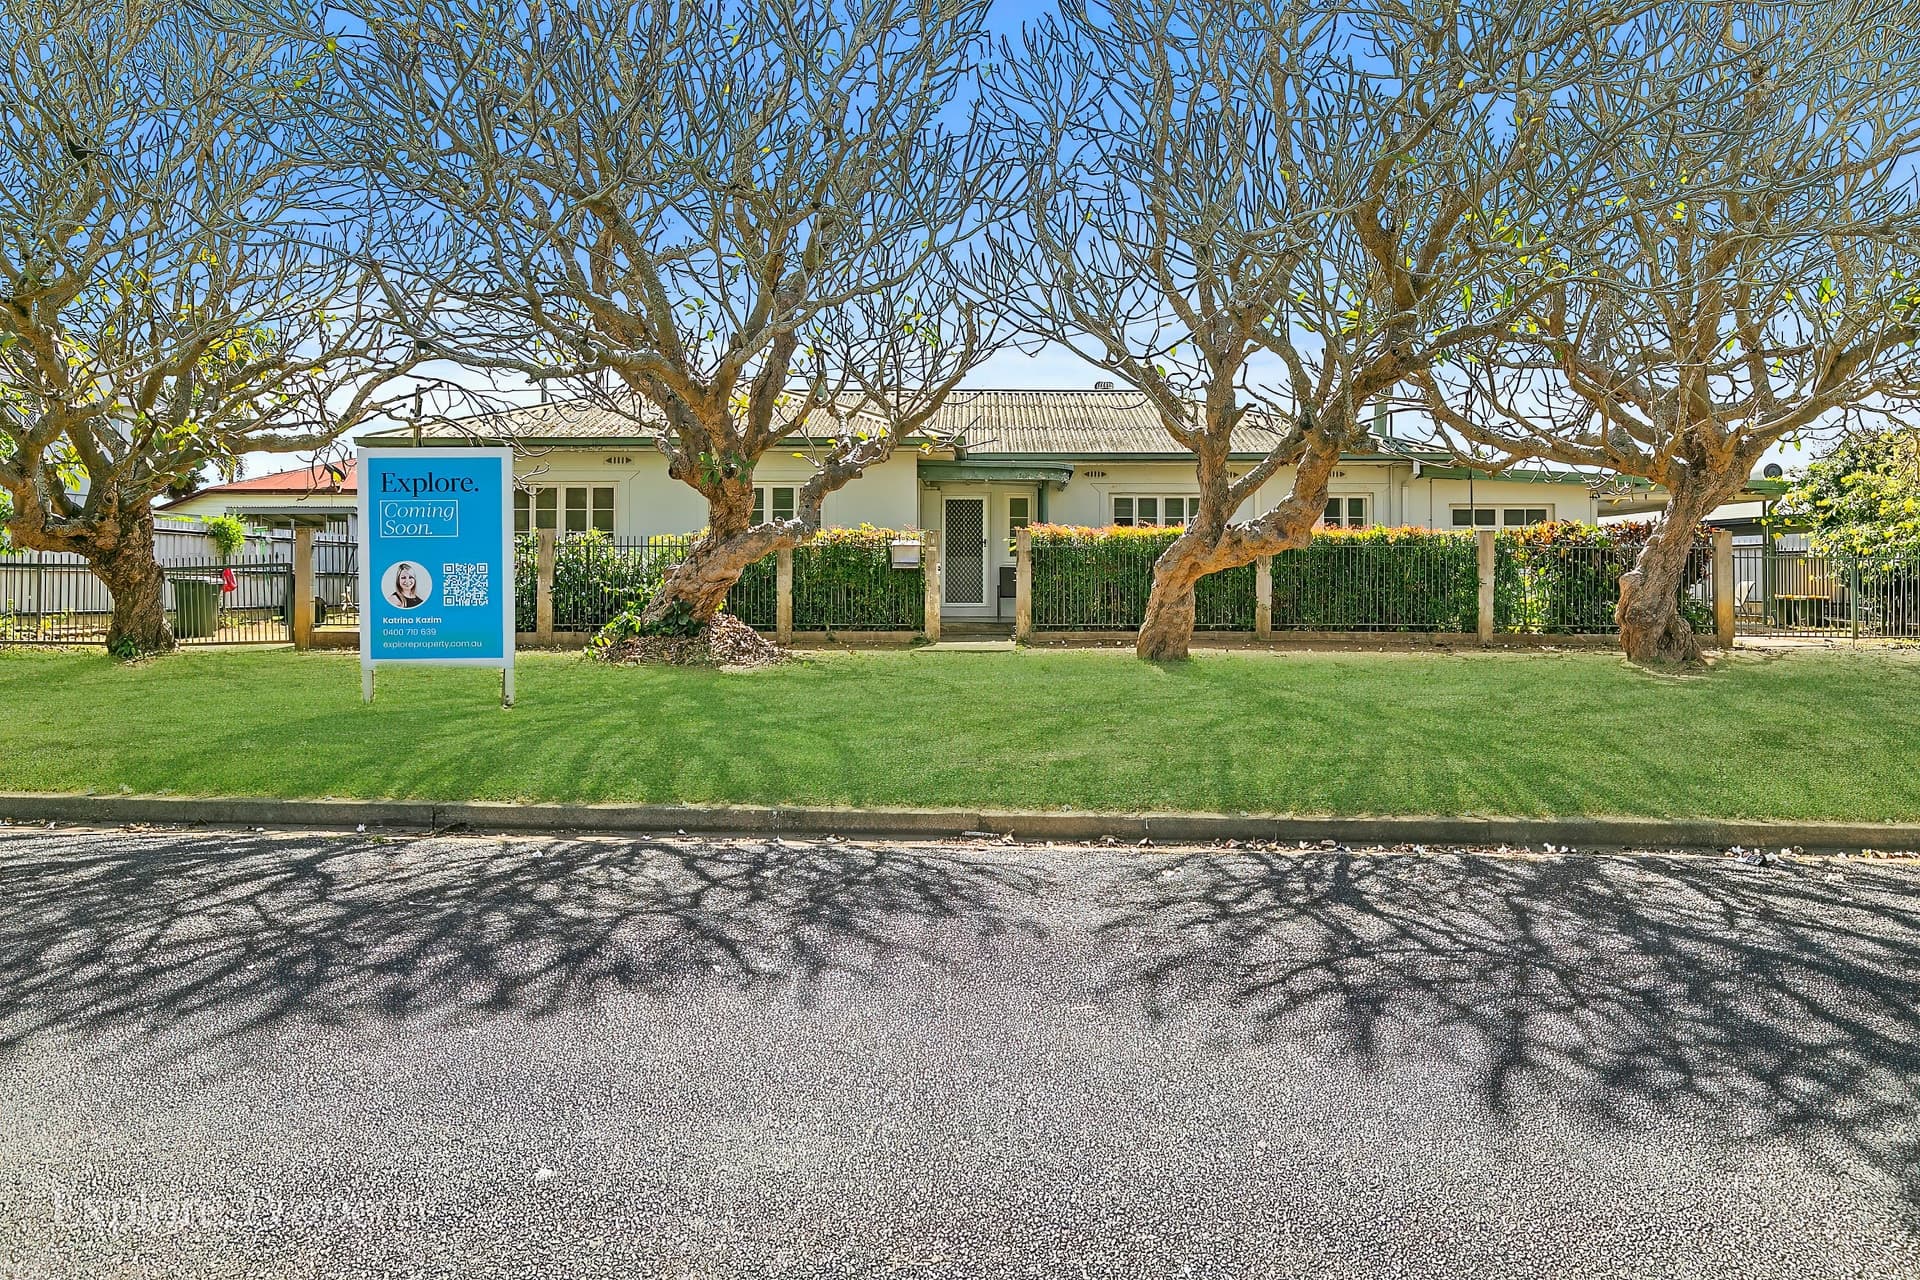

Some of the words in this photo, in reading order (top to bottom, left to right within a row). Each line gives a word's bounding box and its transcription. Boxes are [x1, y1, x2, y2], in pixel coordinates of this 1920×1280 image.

[381, 472, 479, 498] Explore.
[384, 502, 454, 521] Coming
[384, 519, 433, 535] Soon.
[382, 616, 414, 625] Katrina
[415, 616, 442, 624] Kazim
[383, 628, 404, 636] 0400
[406, 628, 419, 636] 710
[420, 627, 437, 636] 639
[383, 640, 482, 649] exploreproperty.com.au
